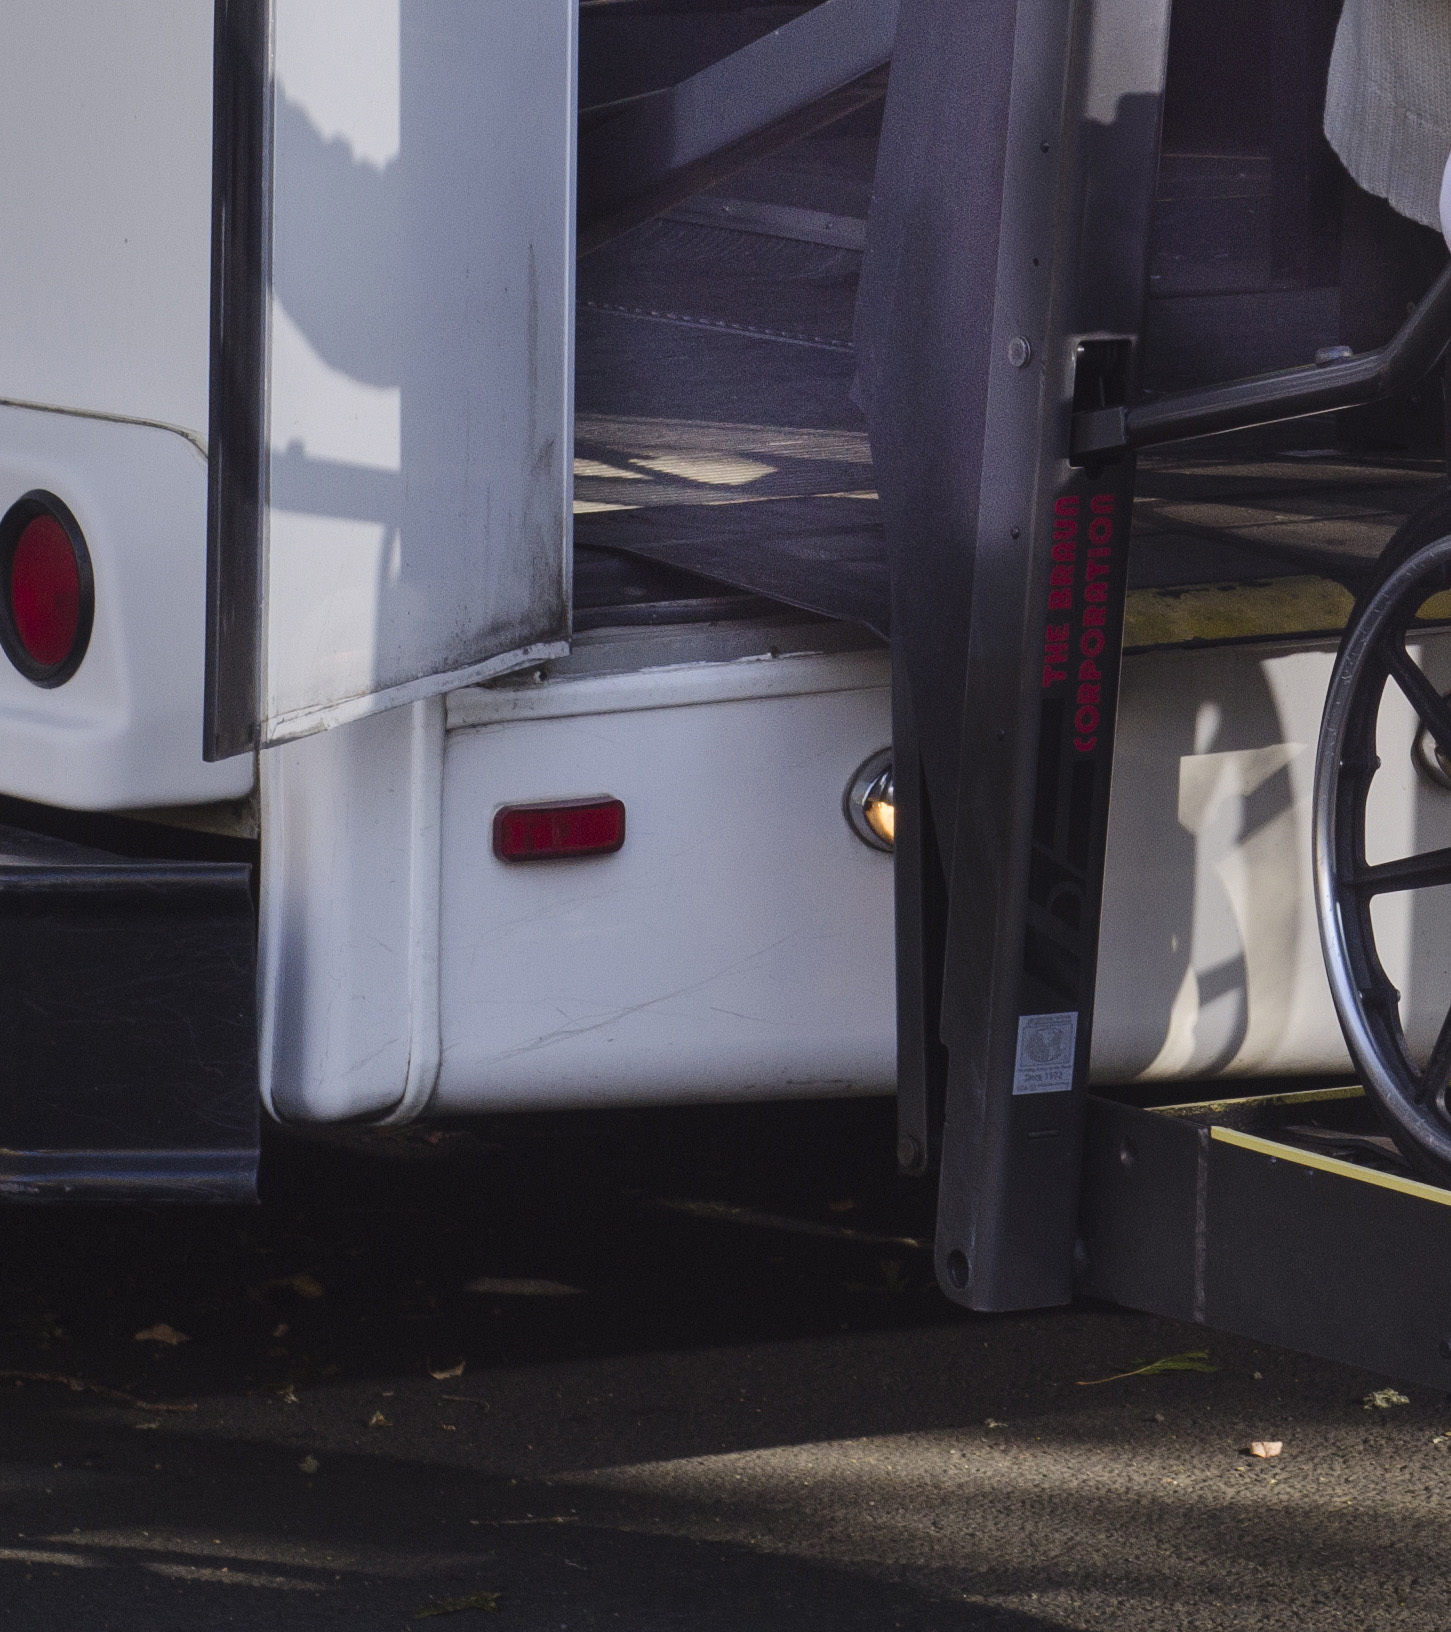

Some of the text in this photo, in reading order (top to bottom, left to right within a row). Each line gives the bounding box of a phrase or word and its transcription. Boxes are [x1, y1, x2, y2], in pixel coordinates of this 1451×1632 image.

[1042, 495, 1080, 689] THE BRAUN
[1073, 493, 1116, 753] CORPORATION
